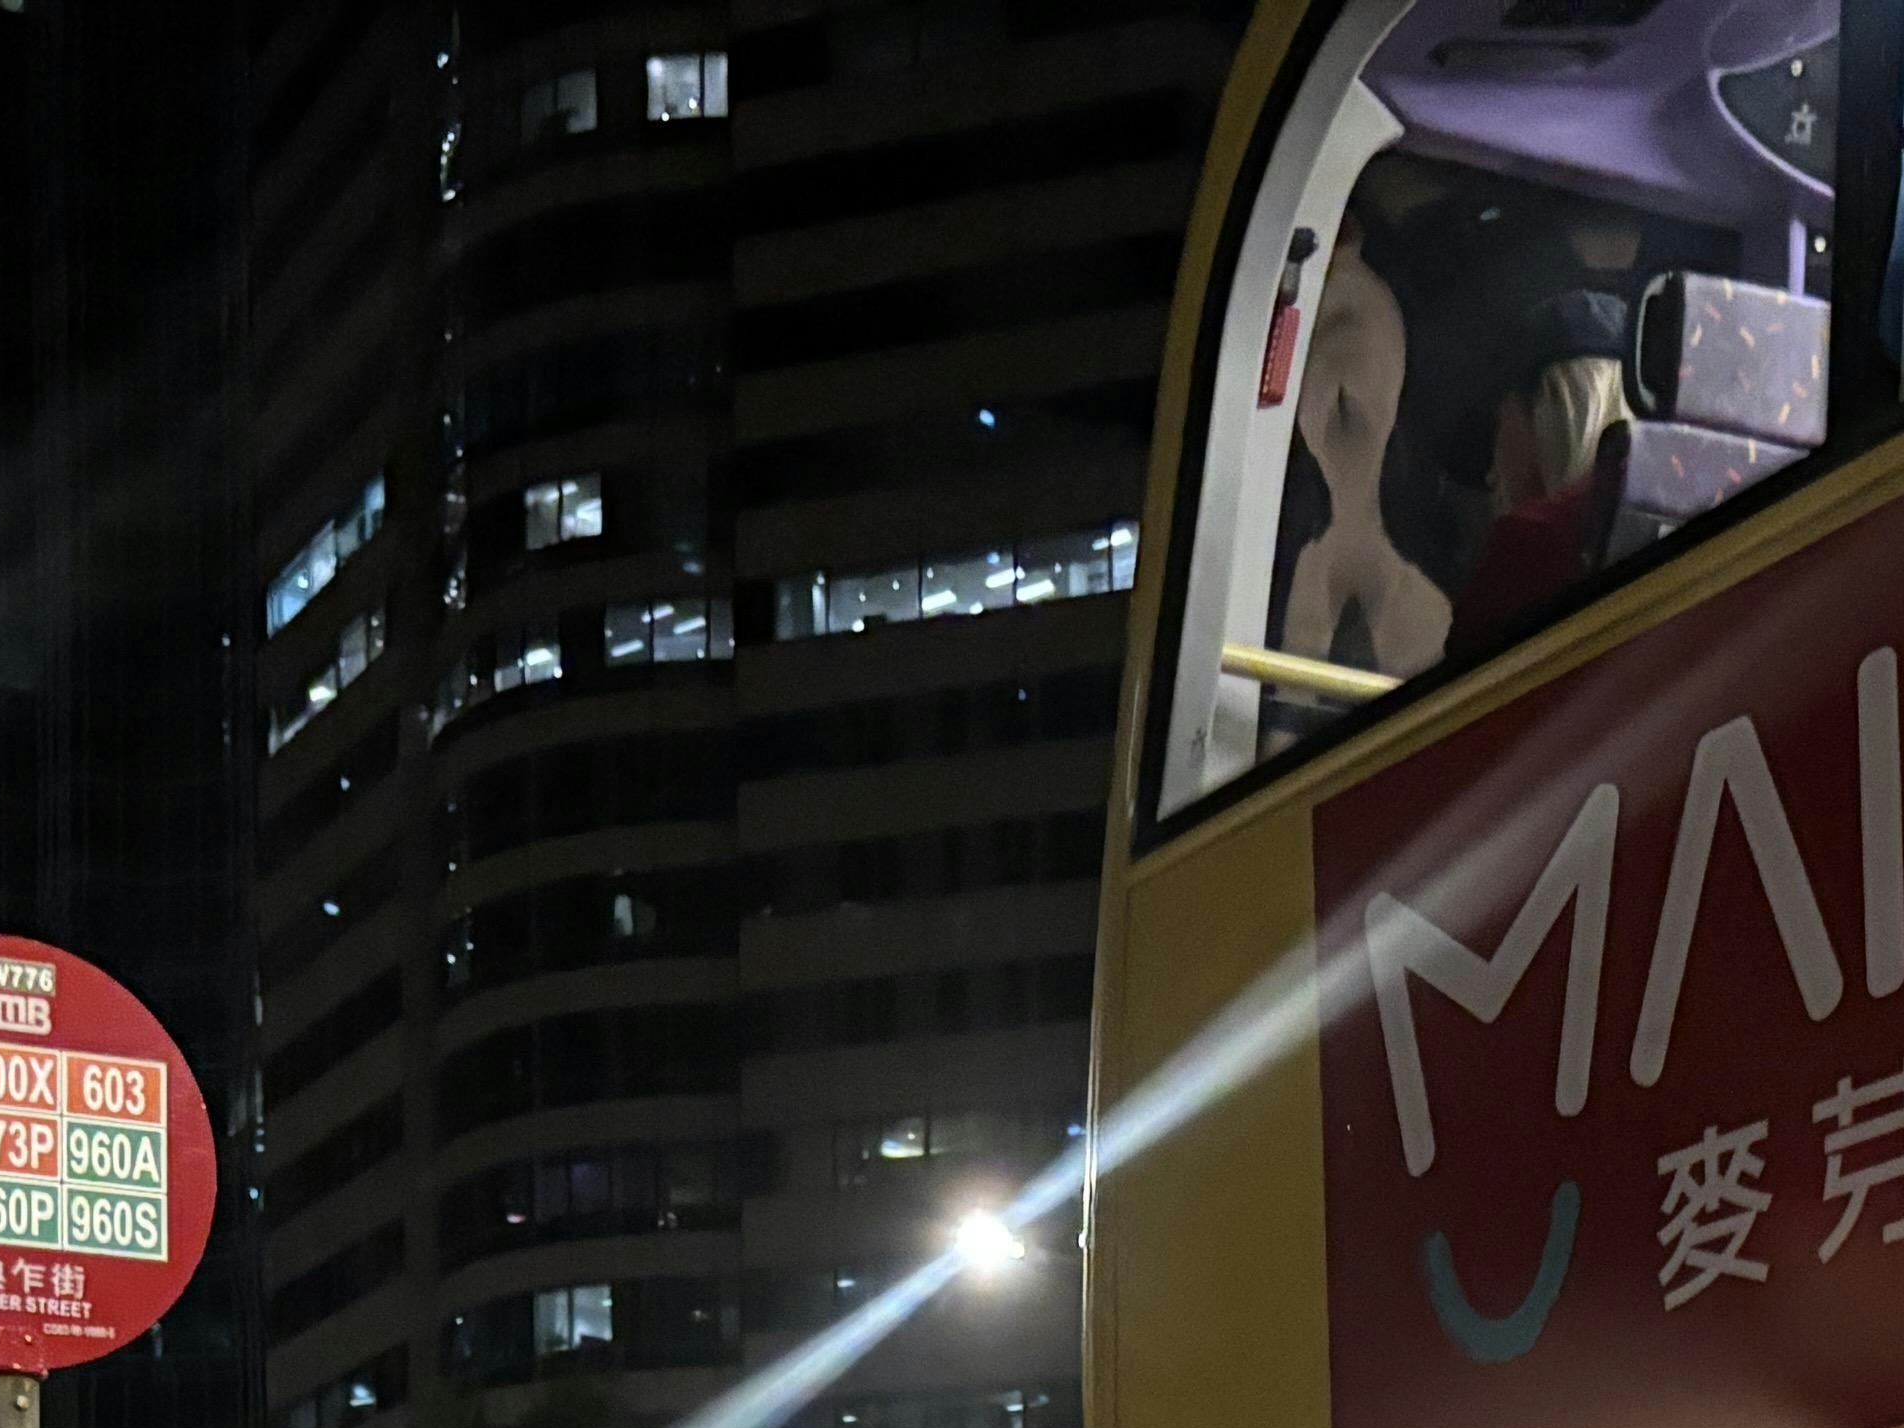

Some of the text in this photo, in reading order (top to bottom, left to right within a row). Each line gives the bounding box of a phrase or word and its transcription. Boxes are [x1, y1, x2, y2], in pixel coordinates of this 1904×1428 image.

[82, 1064, 146, 1117] 603
[69, 1128, 160, 1182] 960A
[70, 1199, 159, 1250] 960S
[25, 1297, 92, 1320] STREET
